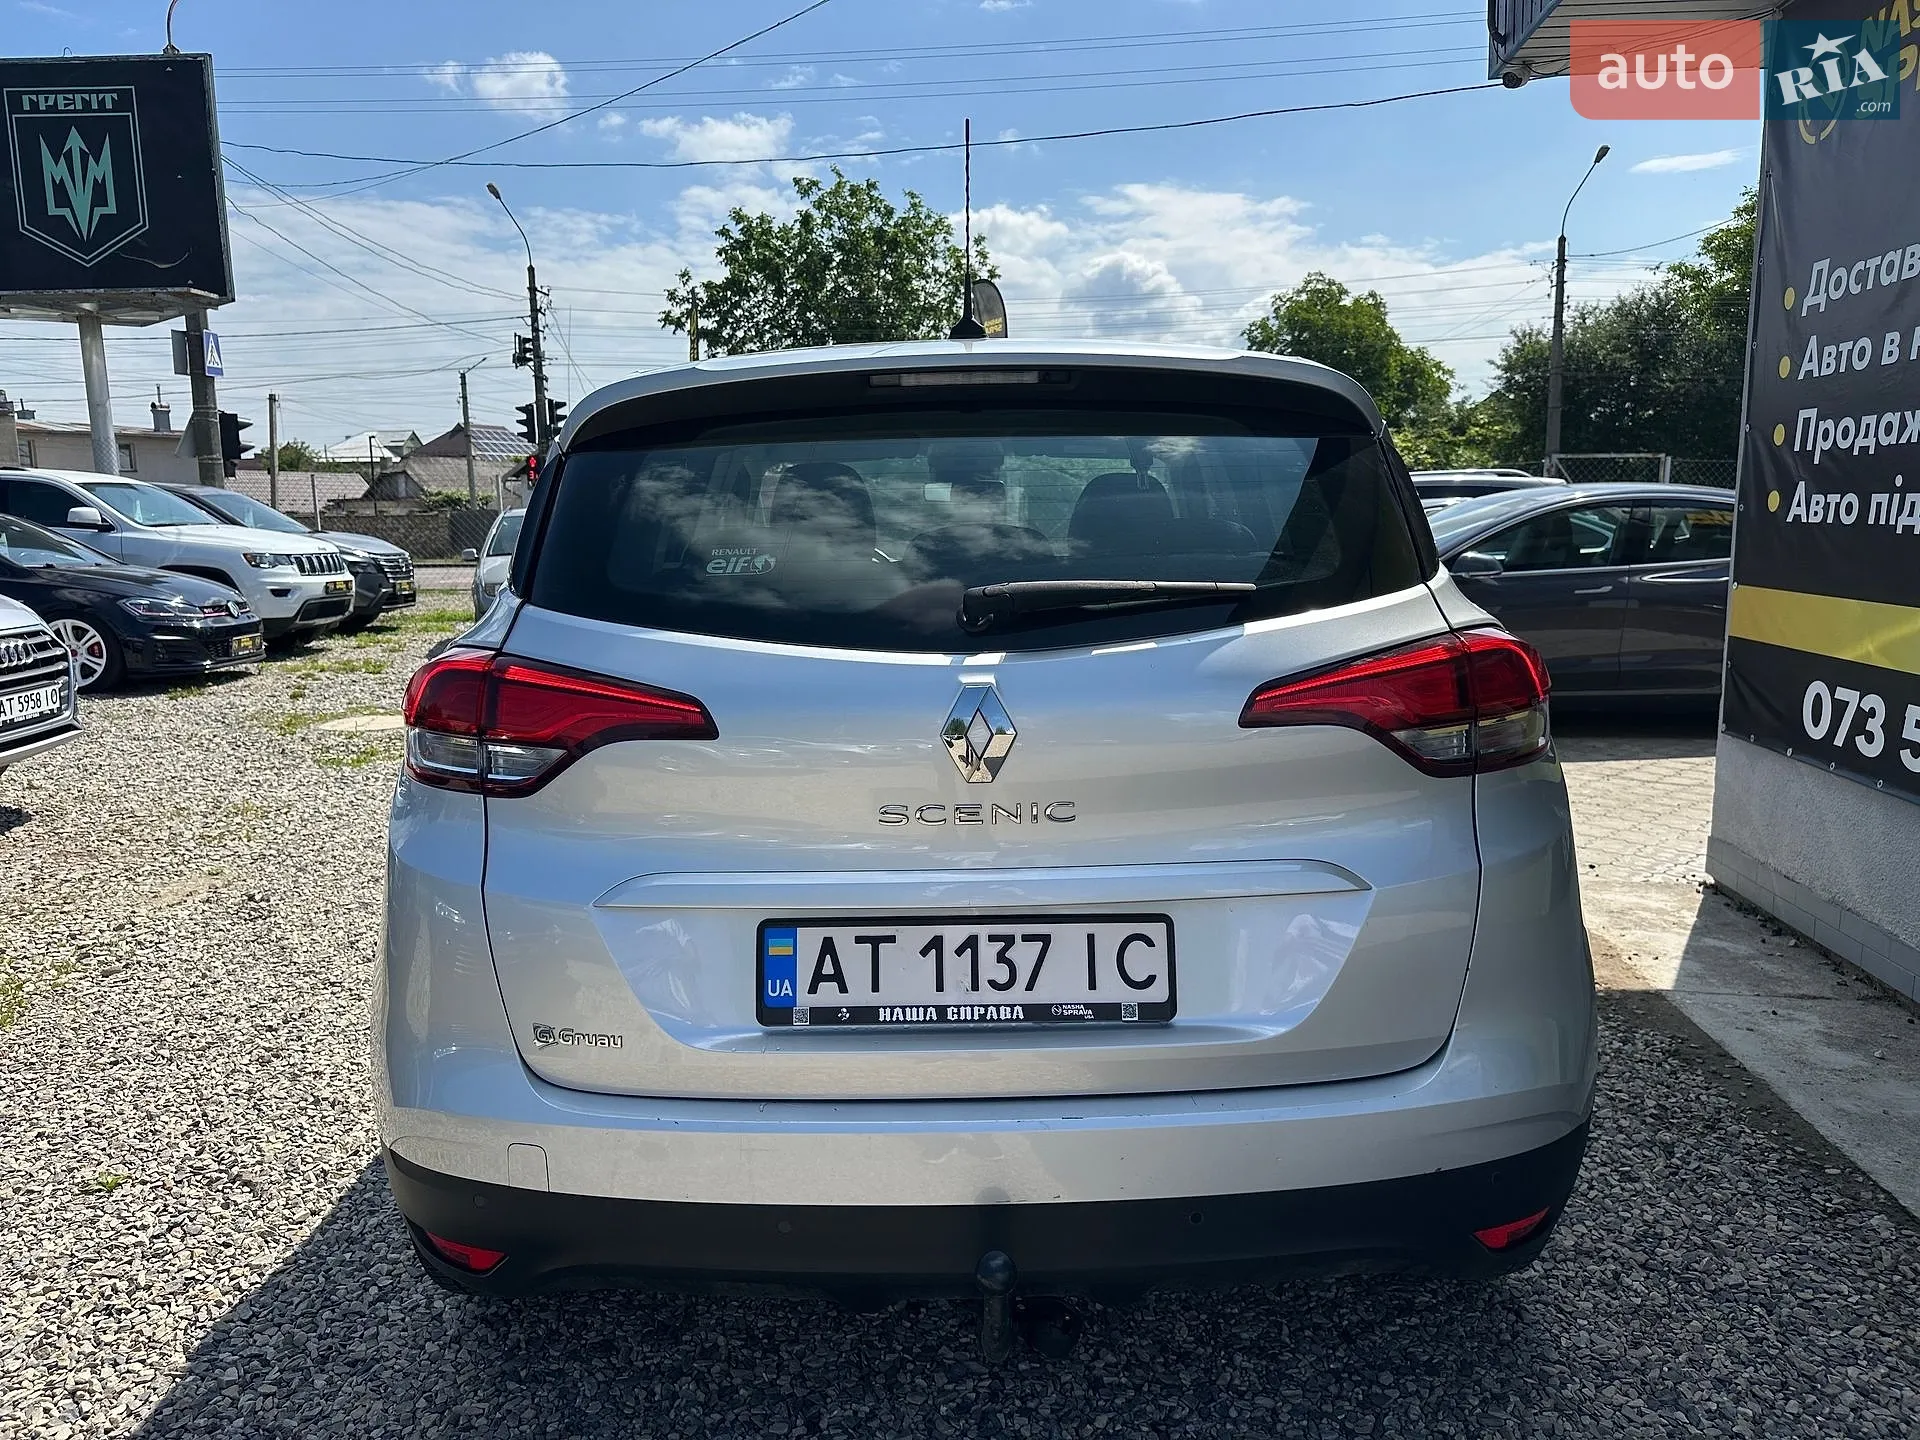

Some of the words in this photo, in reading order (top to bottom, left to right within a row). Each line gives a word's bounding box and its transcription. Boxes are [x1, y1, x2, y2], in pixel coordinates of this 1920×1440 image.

[1798, 334, 1872, 381] Авто
[1881, 331, 1900, 366] в
[1793, 407, 1920, 465] Продаж
[1786, 481, 1859, 525] Авто
[1867, 474, 1920, 535] під
[711, 547, 758, 556] RENAULT
[706, 556, 752, 574] elf
[18, 691, 41, 713] 5958
[1802, 680, 1886, 758] 073
[878, 801, 1077, 826] SCENIC
[807, 935, 897, 994] AT
[919, 933, 1052, 993] 1137
[1088, 932, 1158, 991] IC
[767, 979, 793, 997] UA
[878, 1006, 937, 1021] НАША
[947, 1004, 1025, 1021] СПРАВА
